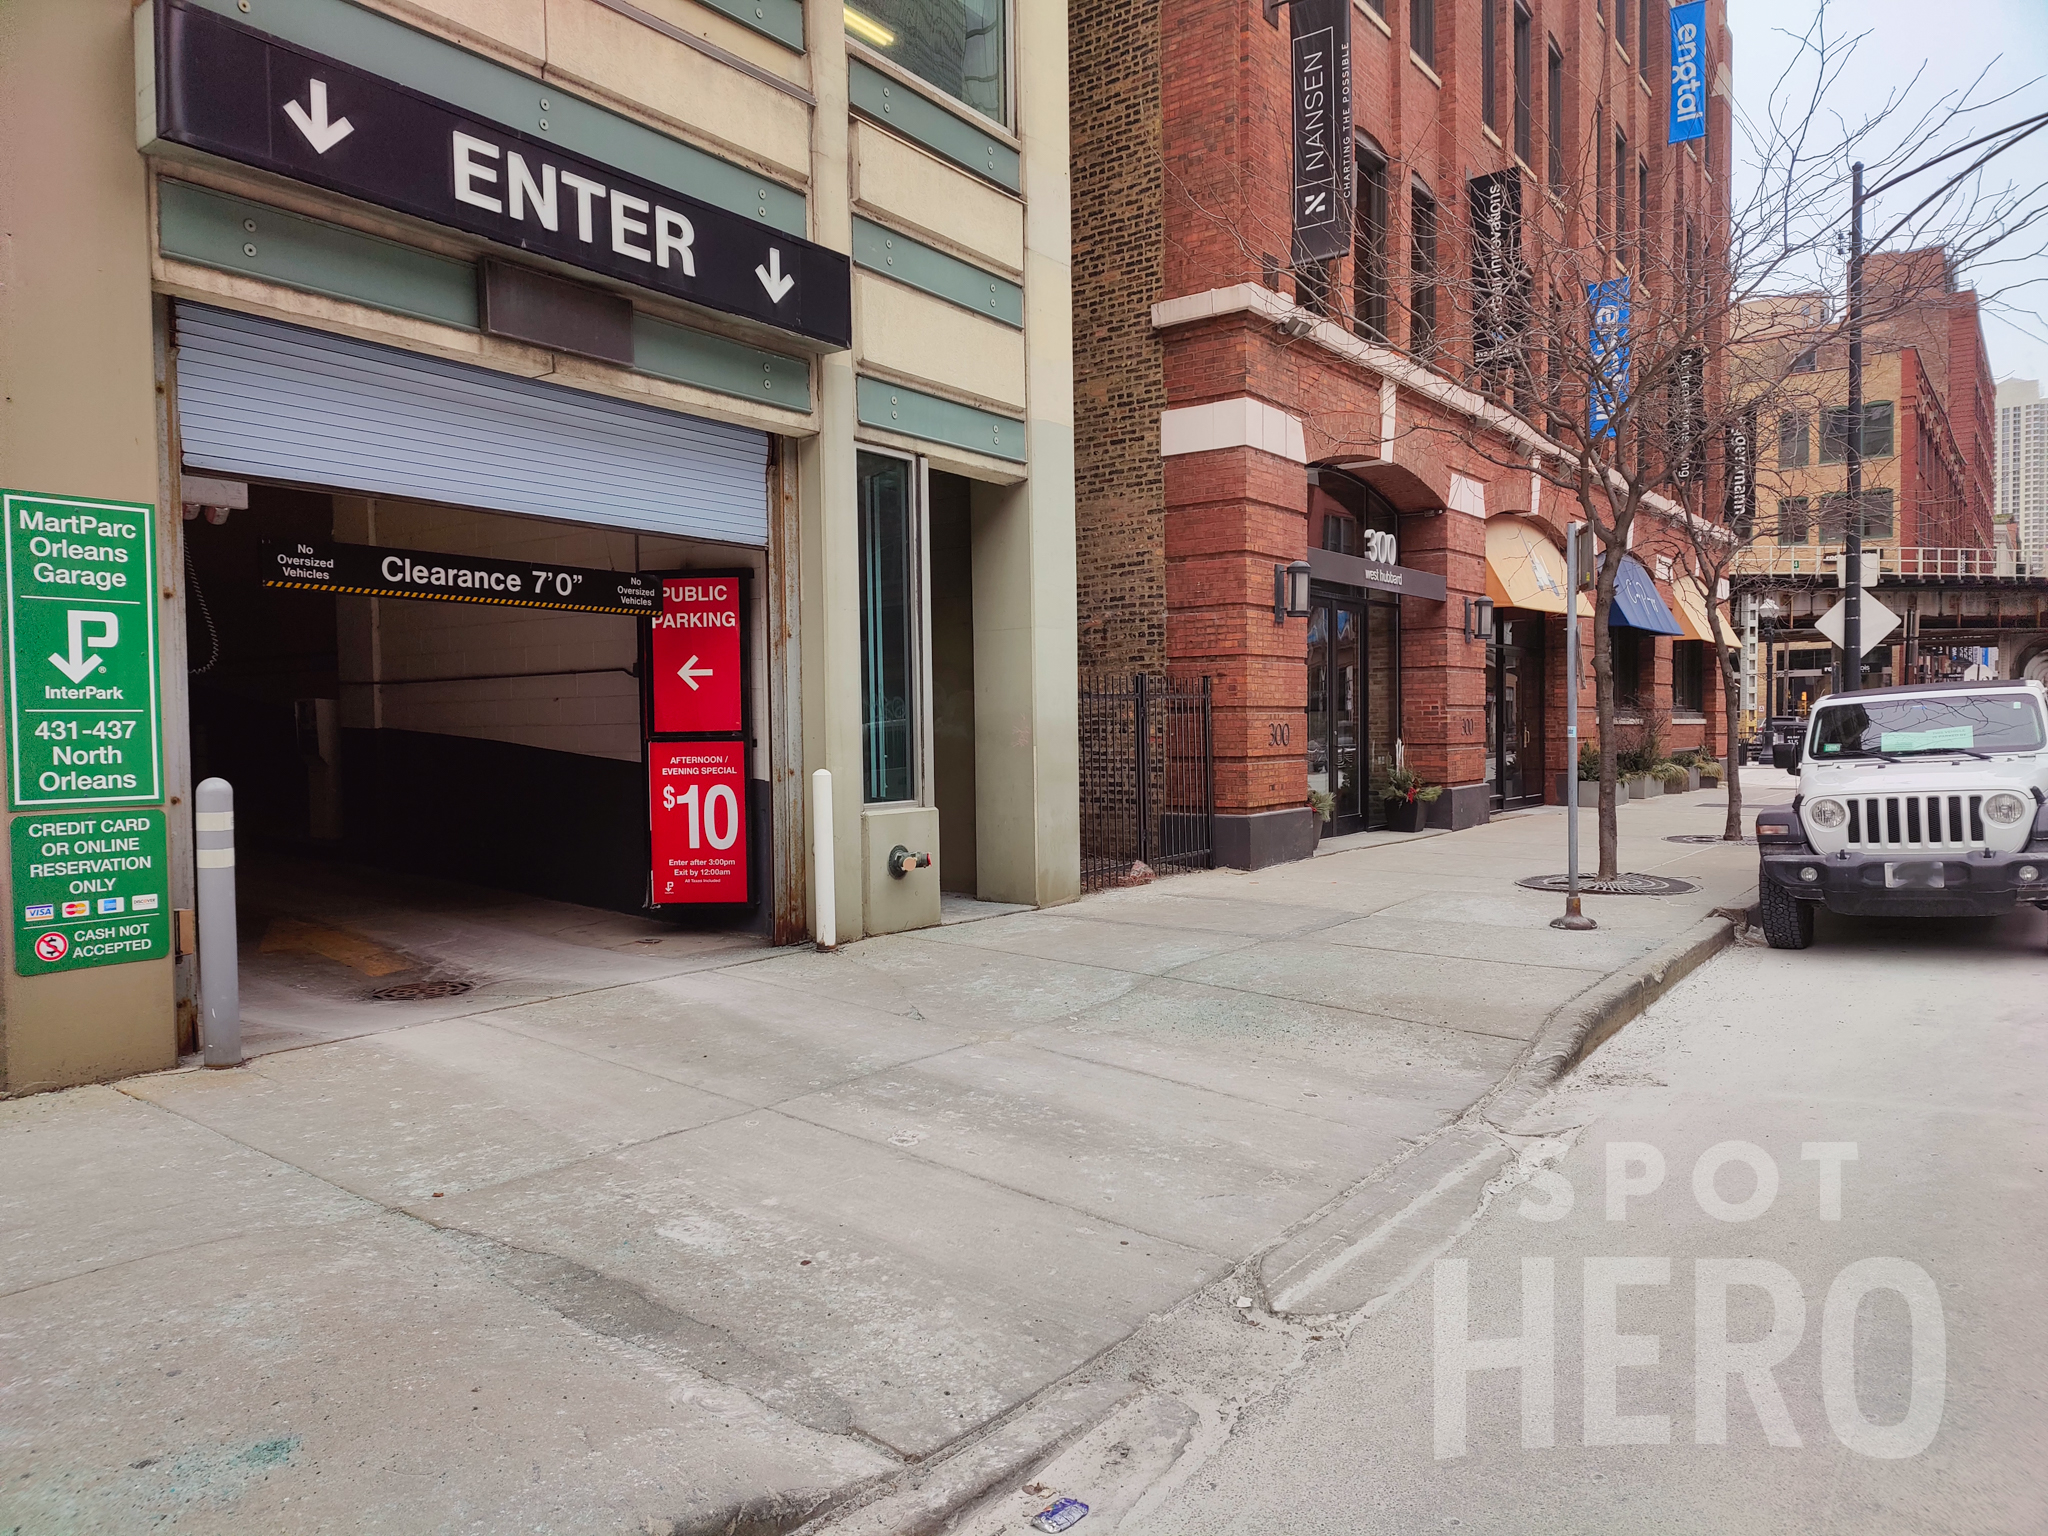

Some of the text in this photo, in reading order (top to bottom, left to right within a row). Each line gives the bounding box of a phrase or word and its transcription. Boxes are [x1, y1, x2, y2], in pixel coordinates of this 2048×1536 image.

[1672, 23, 1704, 122] engtal
[1303, 51, 1325, 171] NANSEN
[1341, 42, 1351, 198] CHARTING THE POSSIBLE
[452, 130, 696, 277] ENTER
[19, 509, 137, 539] MartParc
[29, 536, 129, 563] Orleans
[297, 544, 314, 555] No
[1364, 528, 1397, 566] 300
[277, 554, 334, 569] Oversized
[33, 562, 127, 591] Garage
[282, 566, 330, 580] Vehicles
[382, 556, 522, 593] Clearance
[630, 577, 641, 586] No
[1365, 569, 1403, 585] west hubbard
[617, 586, 655, 597] Oversized
[662, 585, 728, 603] PUBLIC
[620, 596, 652, 607] Vehicles
[652, 611, 736, 629] PARKING
[45, 685, 124, 700] InterPark
[34, 720, 137, 740] 431-437
[1268, 723, 1290, 747] 300
[1461, 718, 1474, 736] 300
[52, 745, 122, 765] North
[670, 756, 723, 765] AFTERNOON
[662, 766, 738, 776] EVENING SPECIAL
[39, 771, 137, 792] Orleans
[663, 784, 739, 850] $10
[28, 817, 151, 838] CREDIT CARD
[41, 837, 140, 857] OR ONLINE
[30, 856, 152, 878] RESERVATION
[668, 858, 736, 867] Enter after 3:00pm
[674, 869, 688, 877] Exit
[689, 868, 699, 877] by
[69, 877, 117, 894] ONLY
[29, 908, 52, 917] VISA
[74, 923, 150, 942] CASH NOT
[72, 938, 152, 959] ACCEPTED
